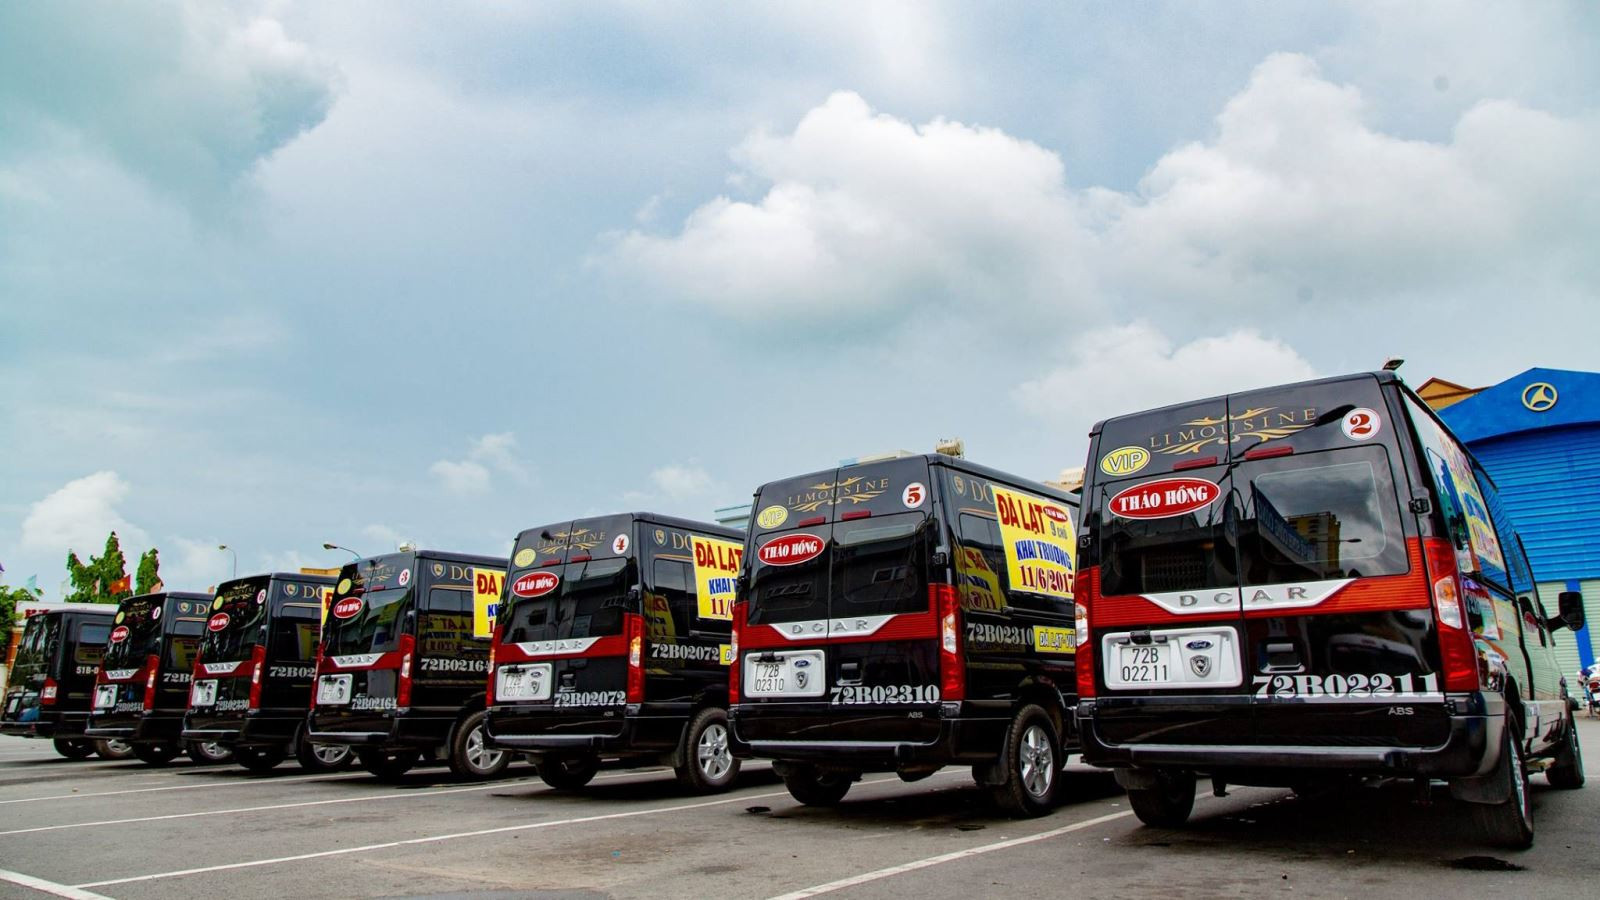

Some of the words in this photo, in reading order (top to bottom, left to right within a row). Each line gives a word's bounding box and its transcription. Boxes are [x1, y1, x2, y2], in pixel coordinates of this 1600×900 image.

[1150, 407, 1318, 448] LIMOUSINE
[1349, 413, 1373, 436] 2
[1107, 452, 1143, 472] VIP
[788, 477, 889, 506] LIMOUSINE
[906, 486, 921, 505] 5
[1119, 490, 1161, 512] THẢO
[762, 509, 785, 527] VIP
[996, 493, 1021, 529] ĐÀ
[1018, 499, 1046, 535] LẠT
[615, 537, 626, 551] 4
[1014, 539, 1038, 561] KHAI
[695, 540, 718, 569] ĐÀ
[476, 572, 498, 596] ĐÀ
[708, 577, 732, 595] KHAI
[1018, 564, 1075, 594] 11/6/2017
[1178, 586, 1309, 607] DCAR
[791, 619, 870, 635] DCAR
[966, 621, 1034, 646] 72B02310
[650, 643, 720, 662] 72B02072
[1188, 640, 1213, 650] Ford
[1131, 647, 1160, 665] 72B
[763, 664, 780, 678] 72B
[829, 684, 941, 706] 72B02310
[1252, 671, 1444, 700] 72B02211
[553, 690, 627, 708] 72B02072
[907, 711, 924, 719] ABS
[1387, 706, 1415, 716] ABS
